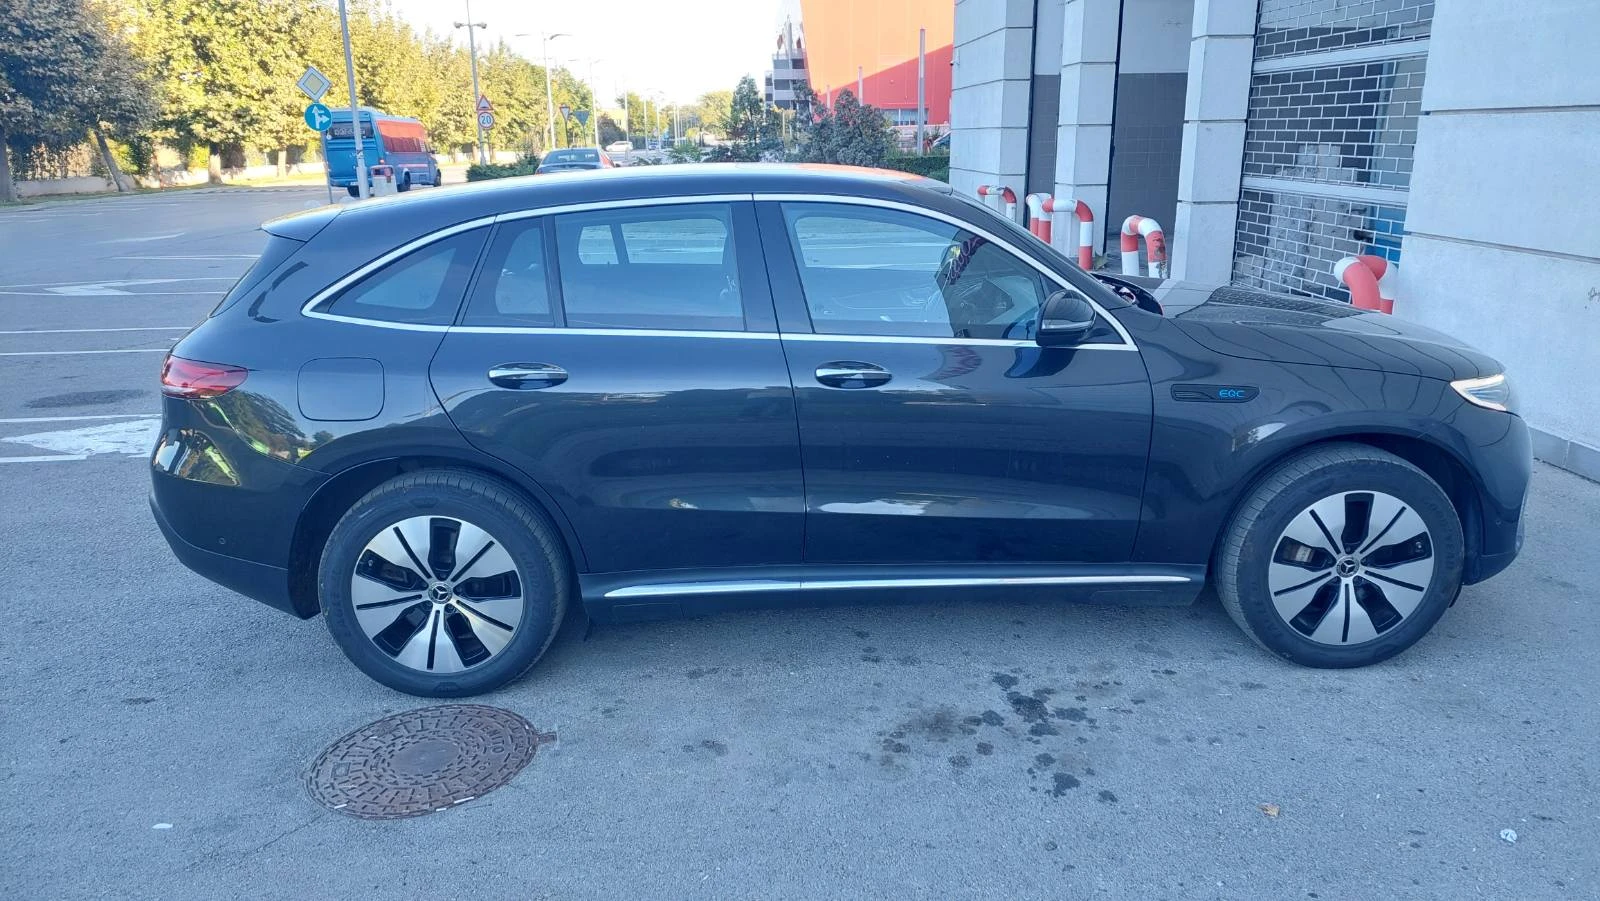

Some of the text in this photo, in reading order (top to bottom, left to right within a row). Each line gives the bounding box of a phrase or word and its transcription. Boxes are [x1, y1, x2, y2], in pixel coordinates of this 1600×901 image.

[481, 115, 491, 125] 20
[1219, 389, 1245, 398] EQC
[472, 722, 505, 754] BENITO
